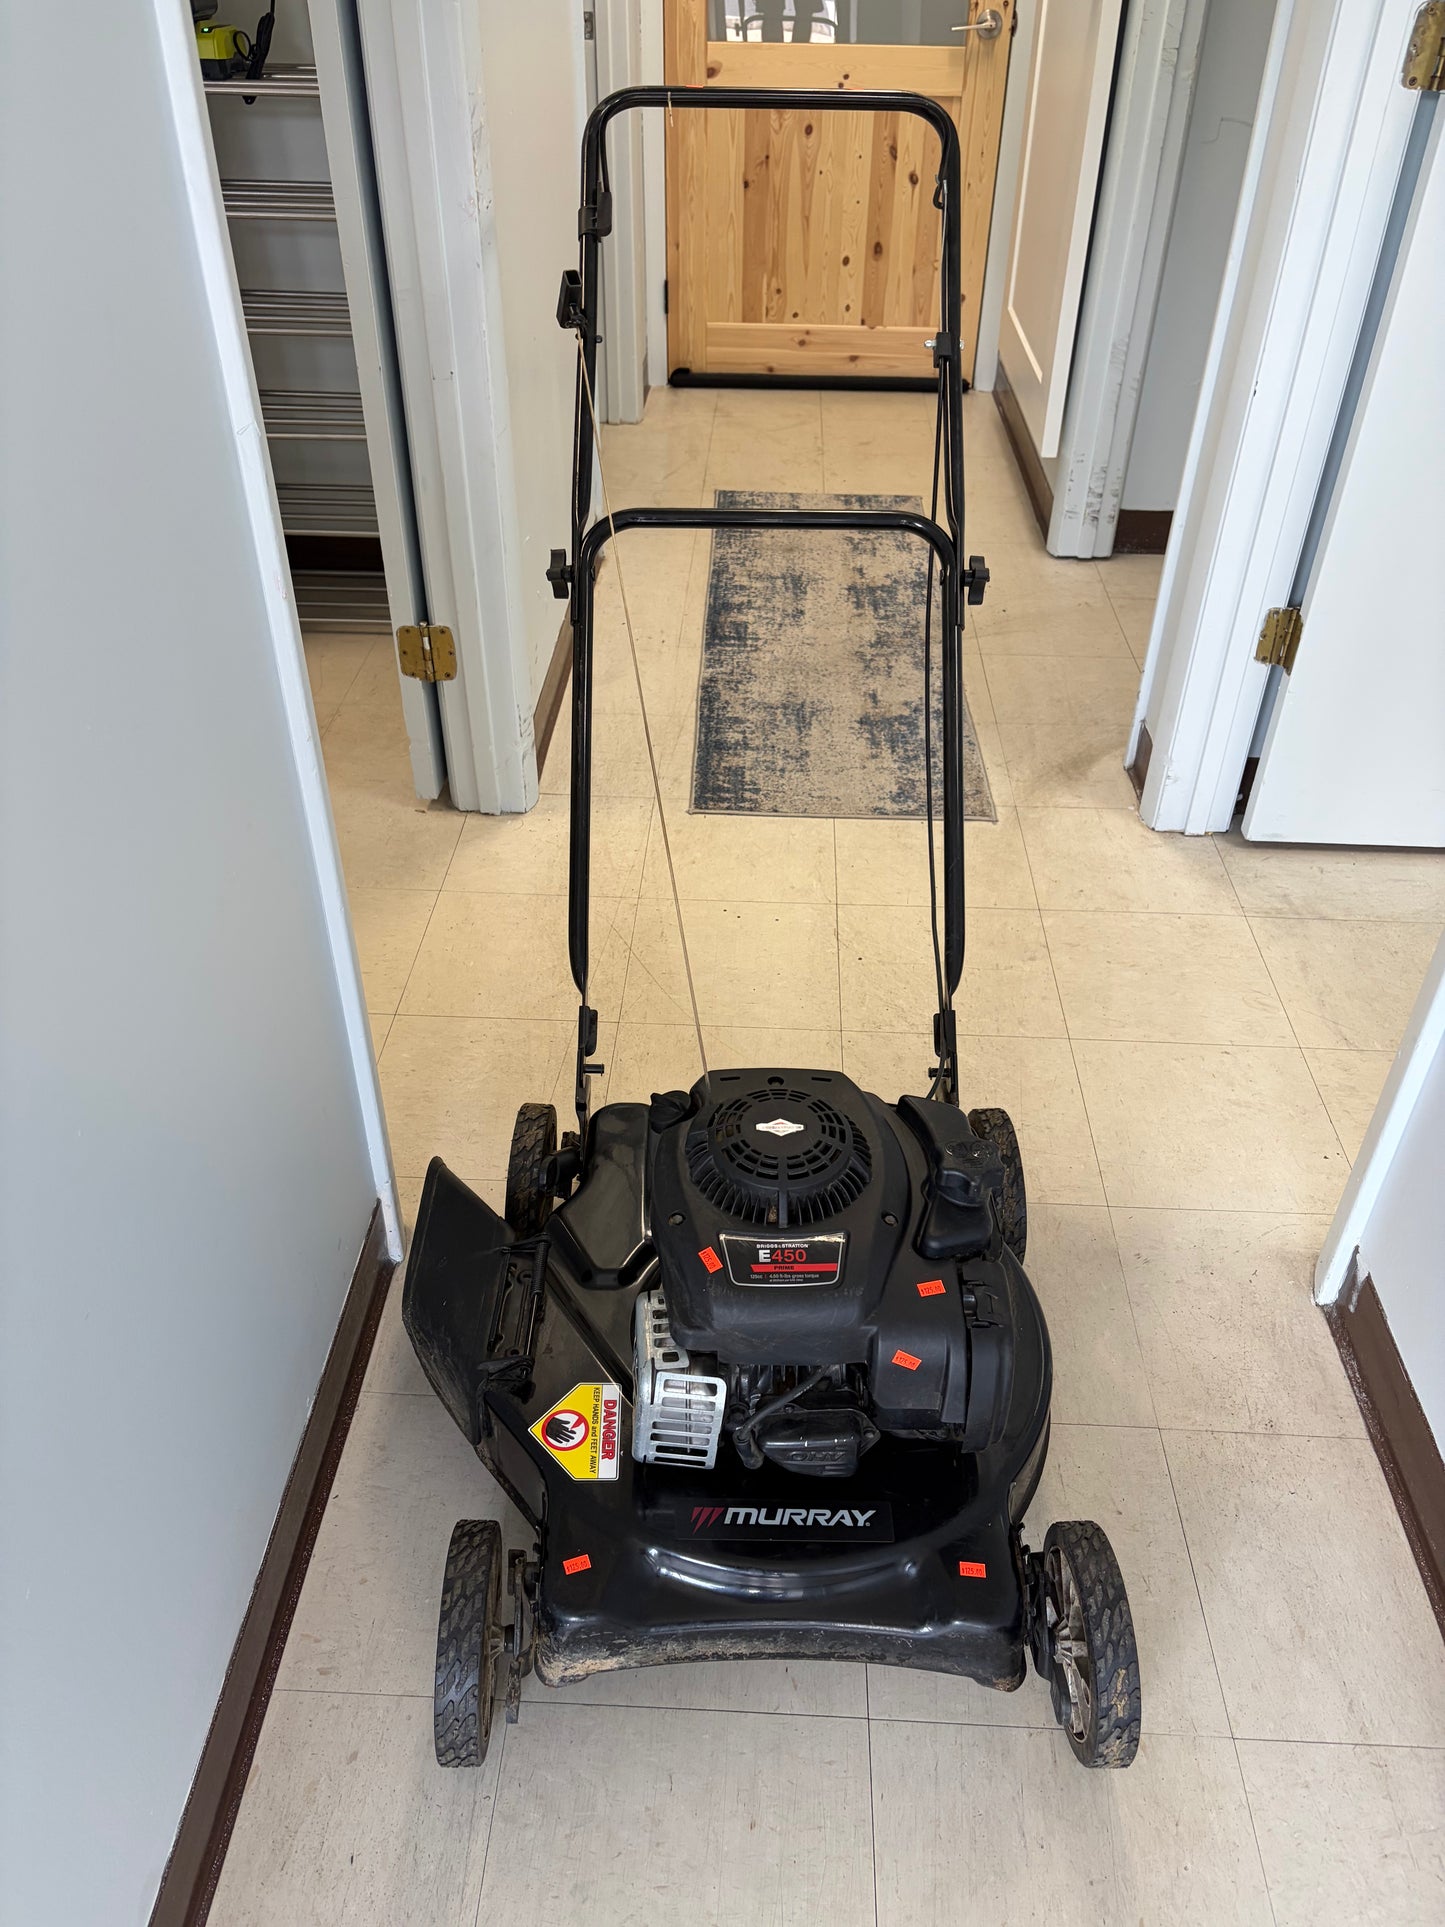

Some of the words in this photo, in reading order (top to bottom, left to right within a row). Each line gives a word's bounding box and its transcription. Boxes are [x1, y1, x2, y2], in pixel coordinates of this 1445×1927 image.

[758, 1249, 807, 1262] E450
[601, 1399, 617, 1460] DANGER
[590, 1439, 598, 1454] FEET
[724, 1507, 876, 1527] MURRAY
